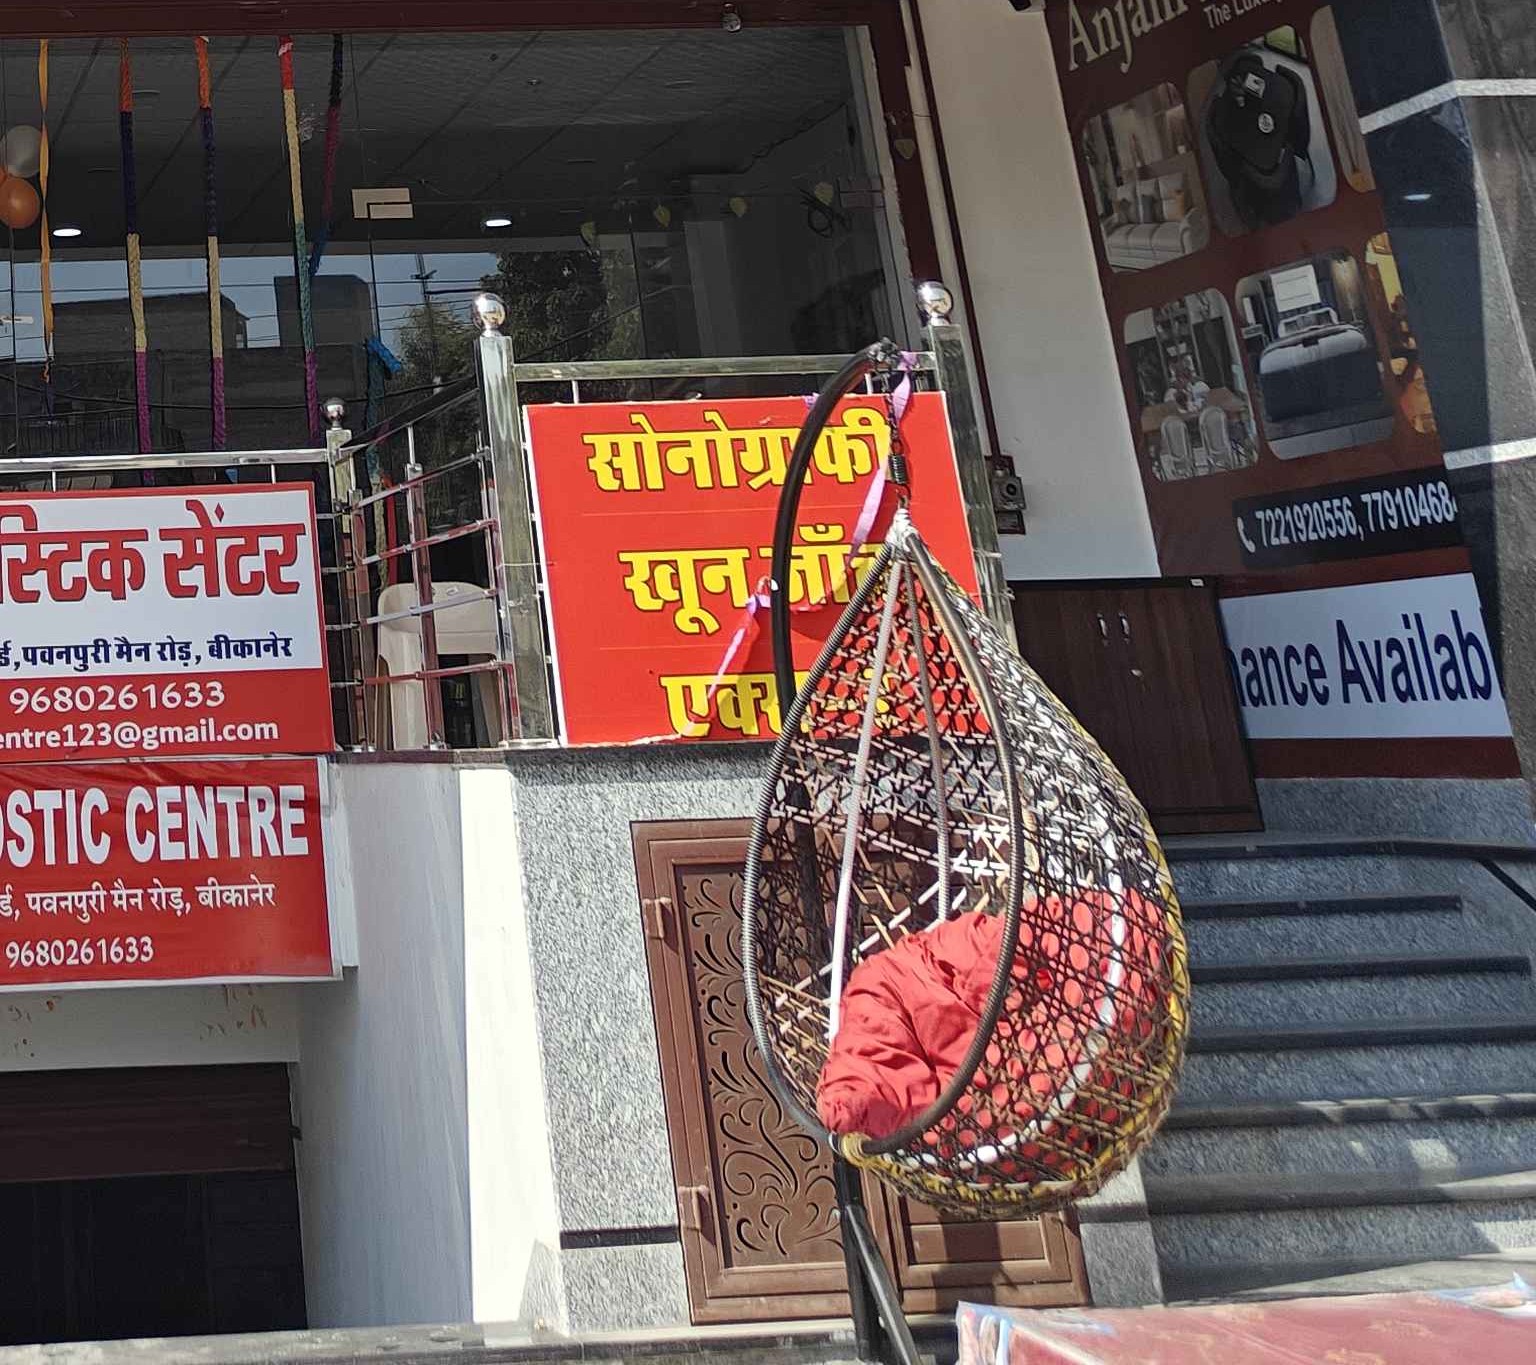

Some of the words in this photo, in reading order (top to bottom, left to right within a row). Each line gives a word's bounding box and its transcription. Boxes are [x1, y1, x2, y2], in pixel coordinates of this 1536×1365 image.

[1203, 3, 1232, 29] The
[159, 499, 307, 599] सेंटर
[618, 546, 753, 635] खून
[22, 638, 111, 672] पवनपुरी
[114, 636, 151, 663] मैन
[207, 631, 293, 660] बीकानेर
[1335, 609, 1492, 704] Availab
[9, 681, 225, 715] 9680261633
[125, 784, 310, 863] CENTRE
[25, 880, 107, 923] पवनपुरी
[110, 877, 144, 912] मैन
[195, 873, 276, 908] बीकानेर
[6, 935, 154, 967] 9680261633
